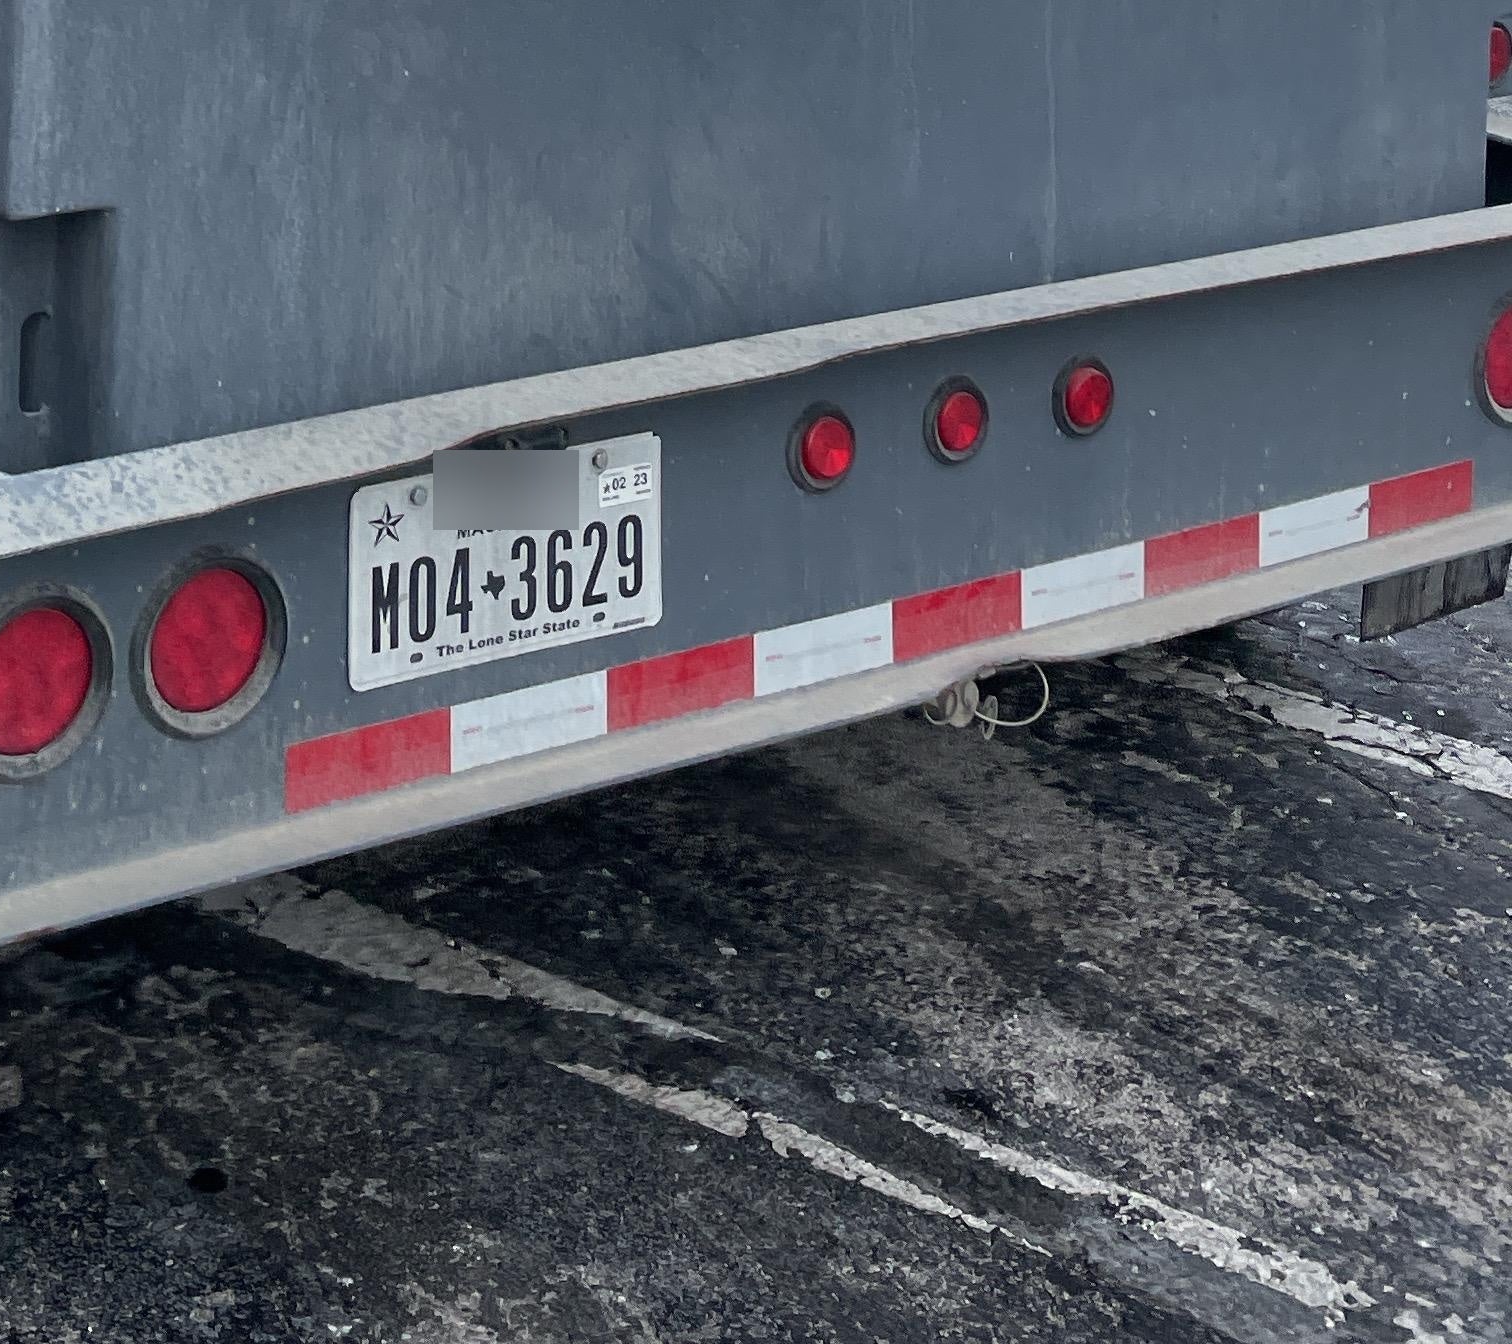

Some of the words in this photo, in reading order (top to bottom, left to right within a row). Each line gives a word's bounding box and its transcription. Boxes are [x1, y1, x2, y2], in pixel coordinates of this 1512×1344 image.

[612, 476, 627, 491] 02
[633, 472, 648, 486] 23
[436, 643, 464, 657] The
[469, 634, 504, 650] Lone
[509, 626, 539, 641] Star
[543, 618, 580, 635] State
